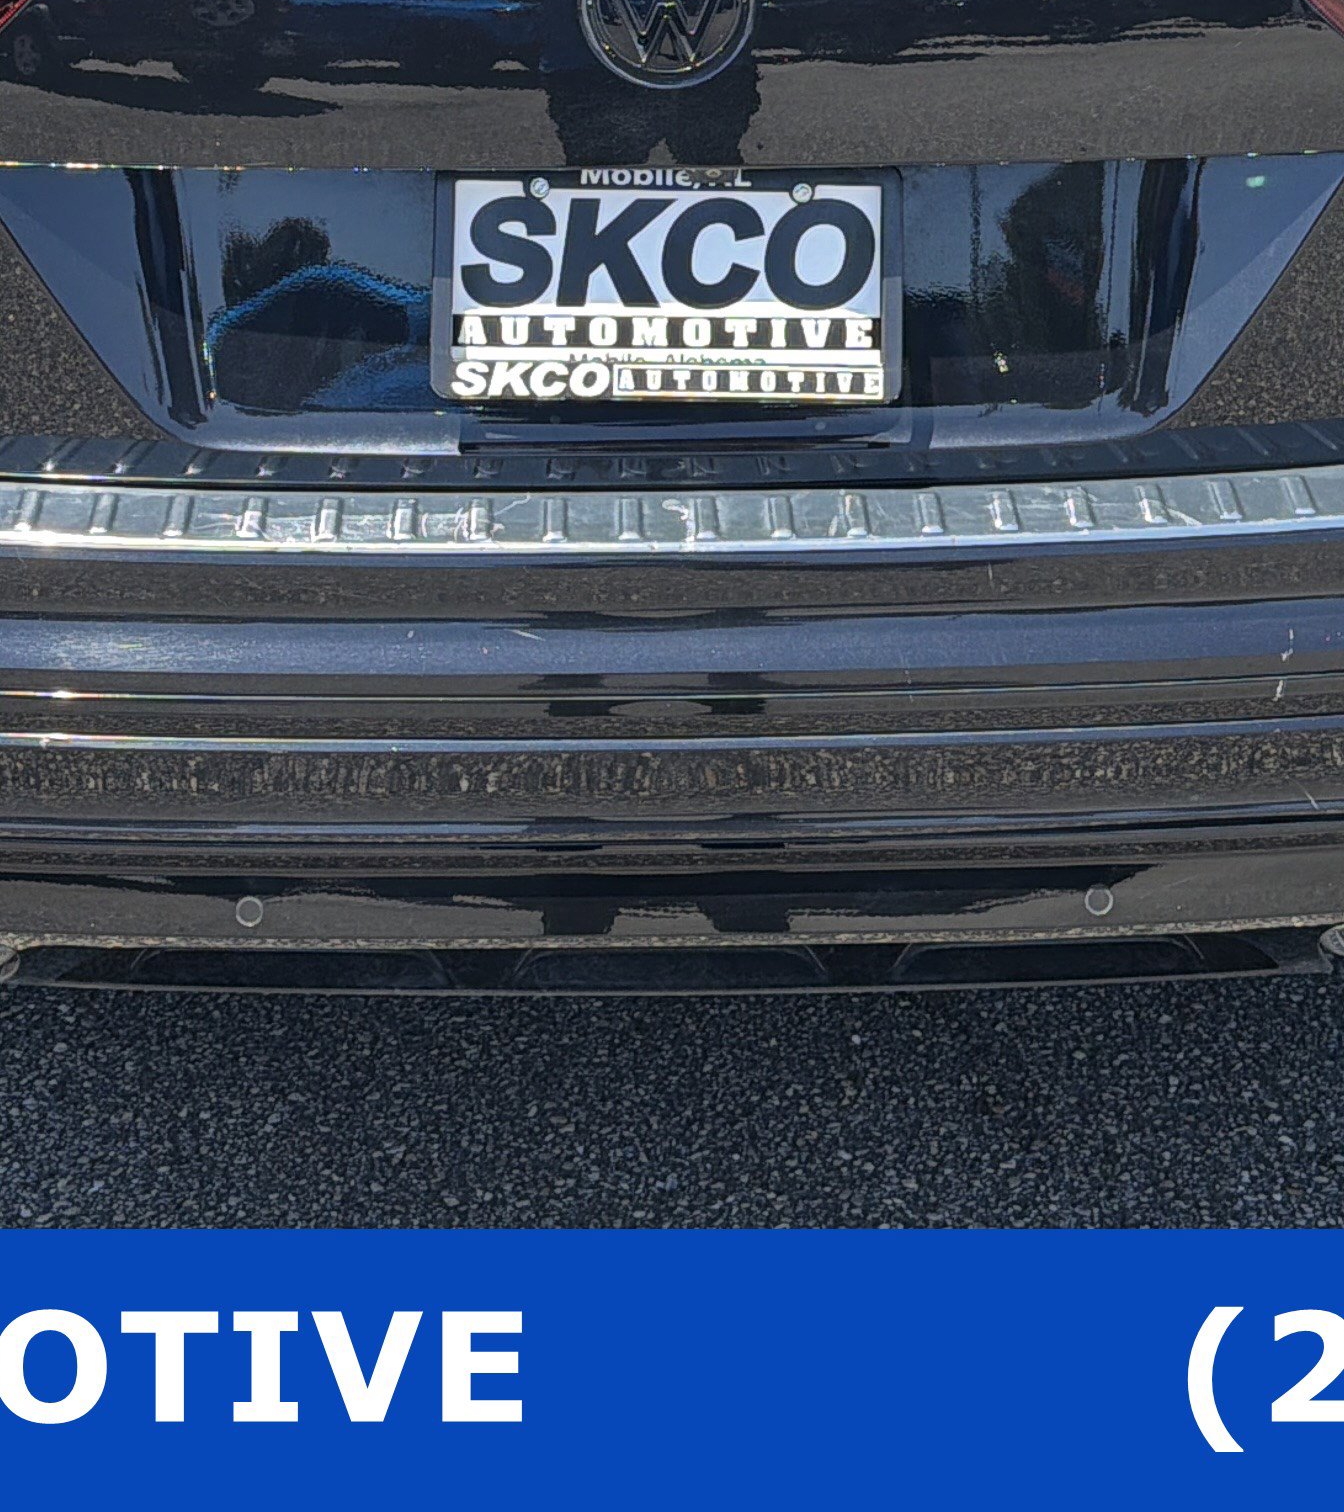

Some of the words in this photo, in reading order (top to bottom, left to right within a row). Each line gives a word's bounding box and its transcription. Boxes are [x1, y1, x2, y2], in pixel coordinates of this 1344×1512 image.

[707, 168, 753, 188] L
[460, 196, 876, 312] SKCO
[459, 316, 873, 349] AUTOMOTIVE
[452, 360, 611, 398] SKCO
[617, 368, 881, 395] AUTOMOTIVE
